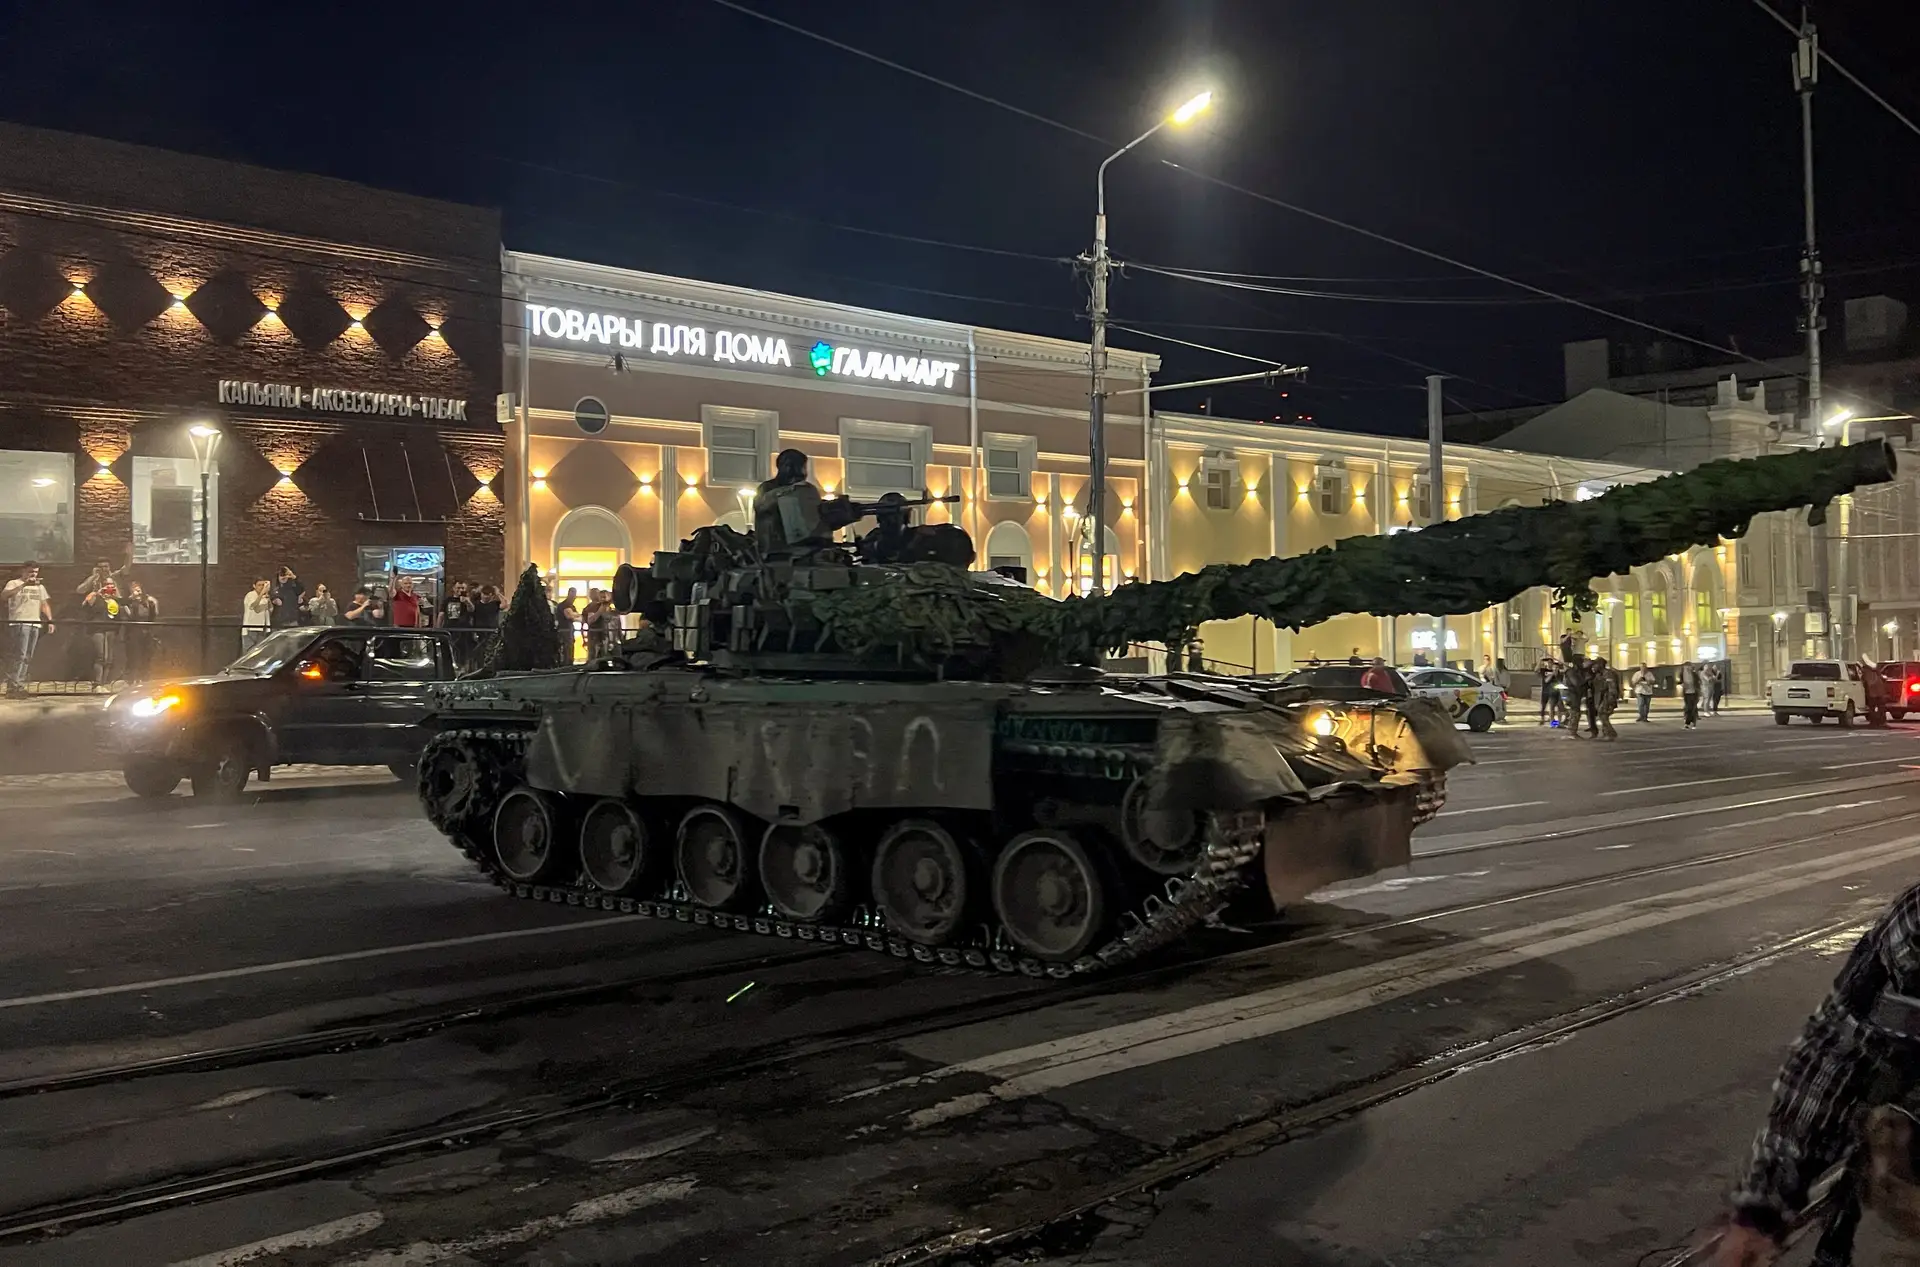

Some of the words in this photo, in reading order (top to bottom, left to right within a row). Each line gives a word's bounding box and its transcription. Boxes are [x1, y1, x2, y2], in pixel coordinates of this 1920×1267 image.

[526, 304, 642, 348] ТОВАРЫ
[651, 322, 706, 356] ДЛЯ
[714, 331, 792, 367] ДОМА
[832, 347, 960, 388] ГАЛАМАРТ
[218, 380, 301, 408] КАЛЬЯНЫ
[311, 387, 412, 416] АКСЕССУАРЫ
[420, 396, 467, 421] ТАБАК
